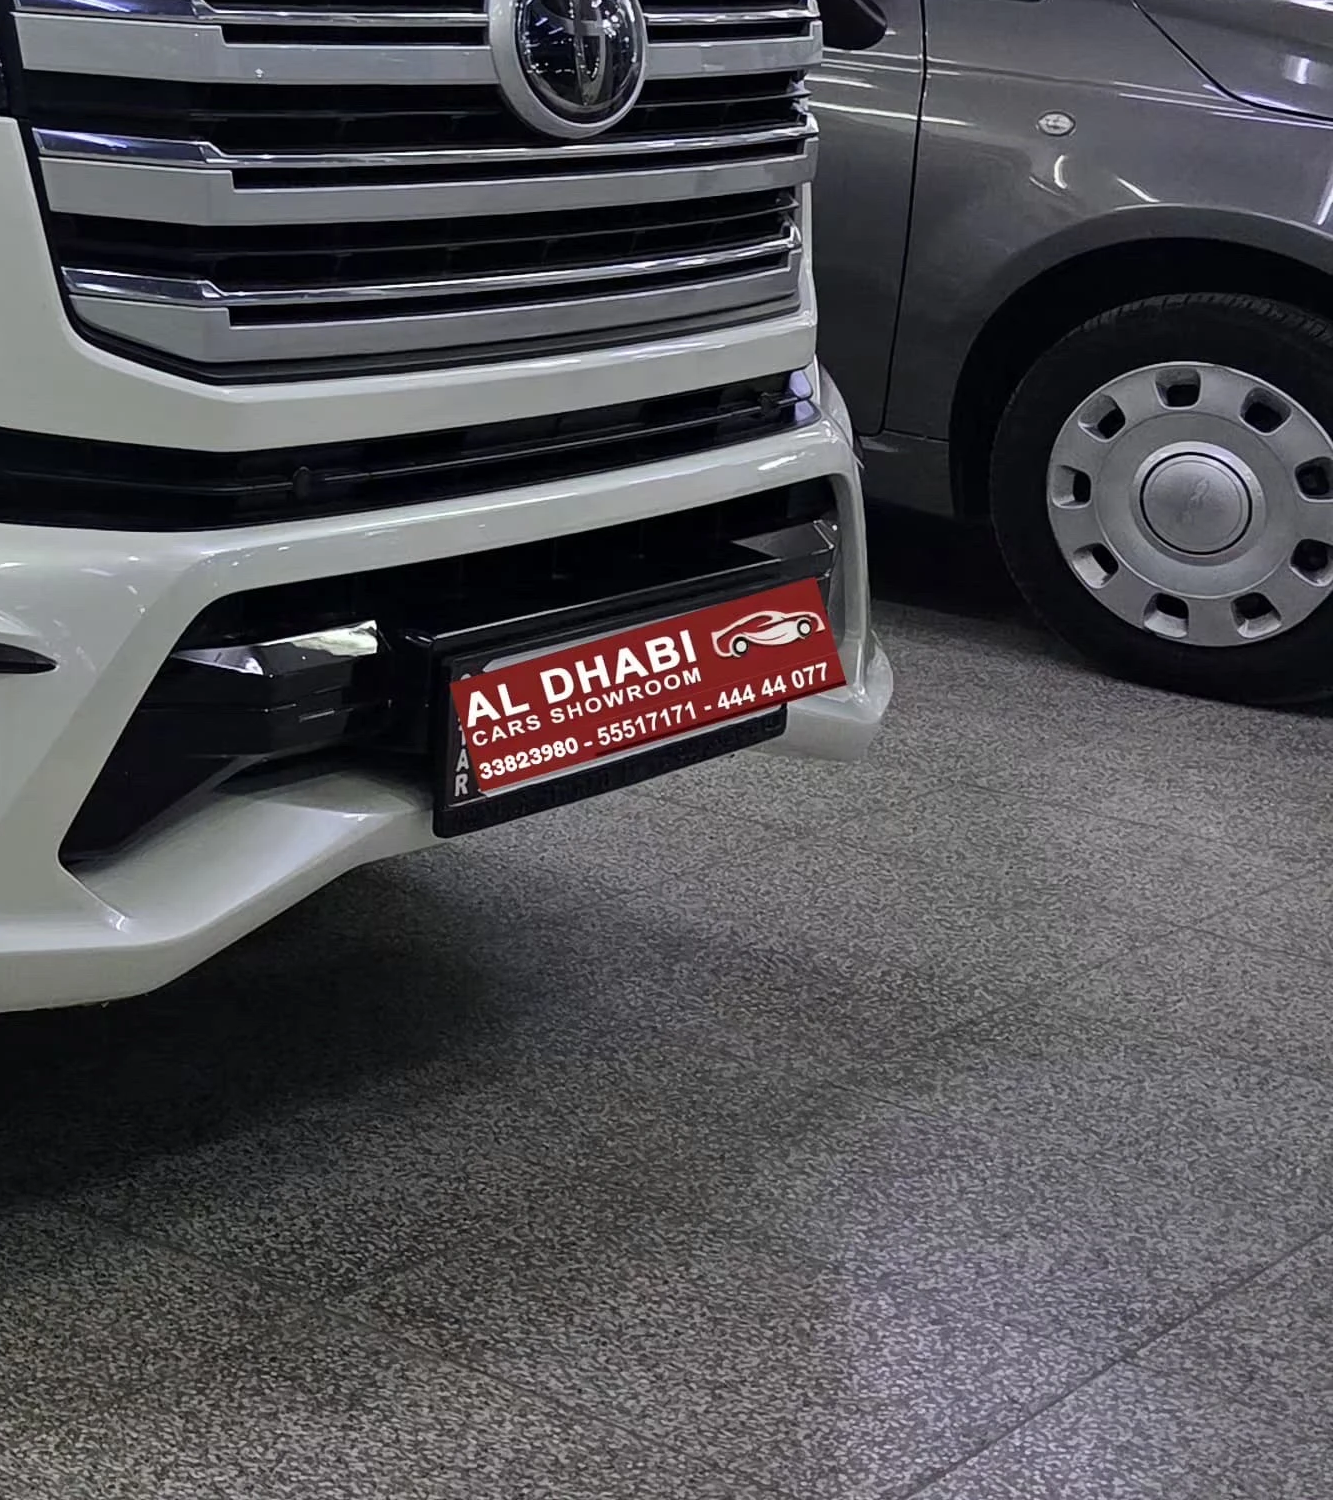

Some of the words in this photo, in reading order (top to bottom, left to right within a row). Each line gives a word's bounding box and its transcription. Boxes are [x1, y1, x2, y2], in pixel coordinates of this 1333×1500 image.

[466, 683, 531, 728] AL
[539, 629, 697, 705] DHABI
[472, 714, 541, 747] CARS
[549, 667, 702, 724] SHOWROOM
[478, 737, 579, 780] 33823980
[597, 701, 697, 746] 55517171
[717, 683, 756, 710] 444
[761, 674, 787, 697] 44
[791, 661, 828, 689] 077
